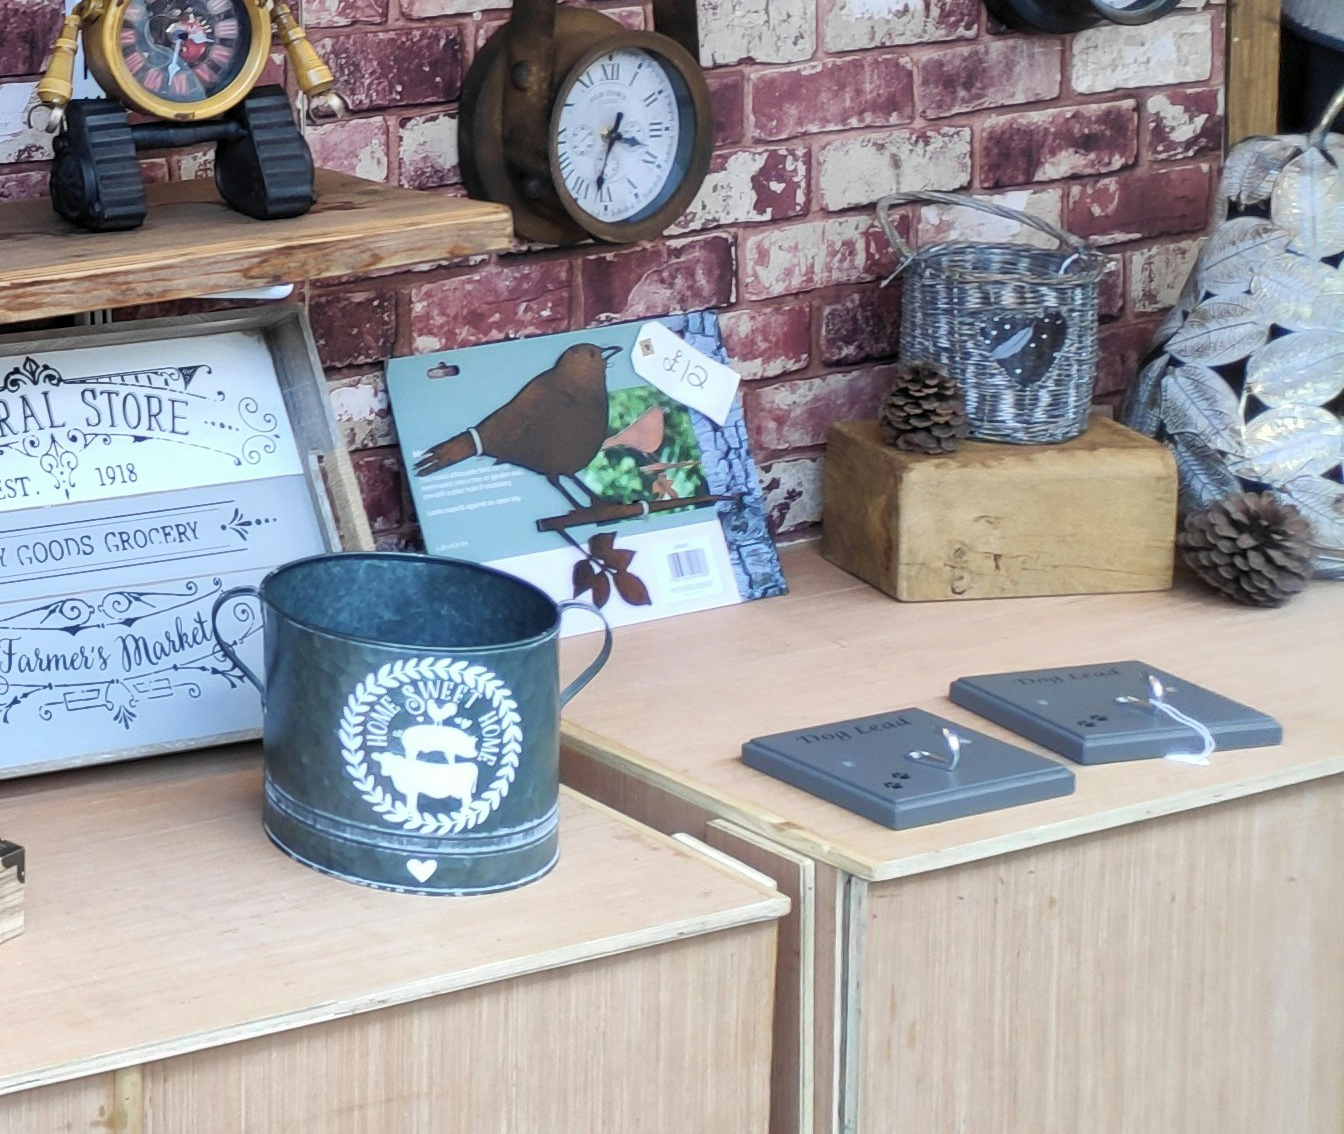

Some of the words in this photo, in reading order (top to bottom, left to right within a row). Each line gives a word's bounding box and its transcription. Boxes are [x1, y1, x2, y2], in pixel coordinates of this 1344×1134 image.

[649, 122, 662, 138] III
[662, 349, 710, 390] £12
[80, 387, 190, 437] STORE
[94, 462, 139, 488] 1918
[15, 534, 95, 566] GOODS
[103, 520, 200, 552] GROCERY
[115, 610, 214, 672] Market
[1015, 674, 1064, 687] Dog
[1064, 668, 1121, 682] Lead
[365, 694, 402, 747] HOME
[476, 709, 502, 767] HOME
[796, 728, 853, 746] Dog
[853, 716, 912, 737] Lead
